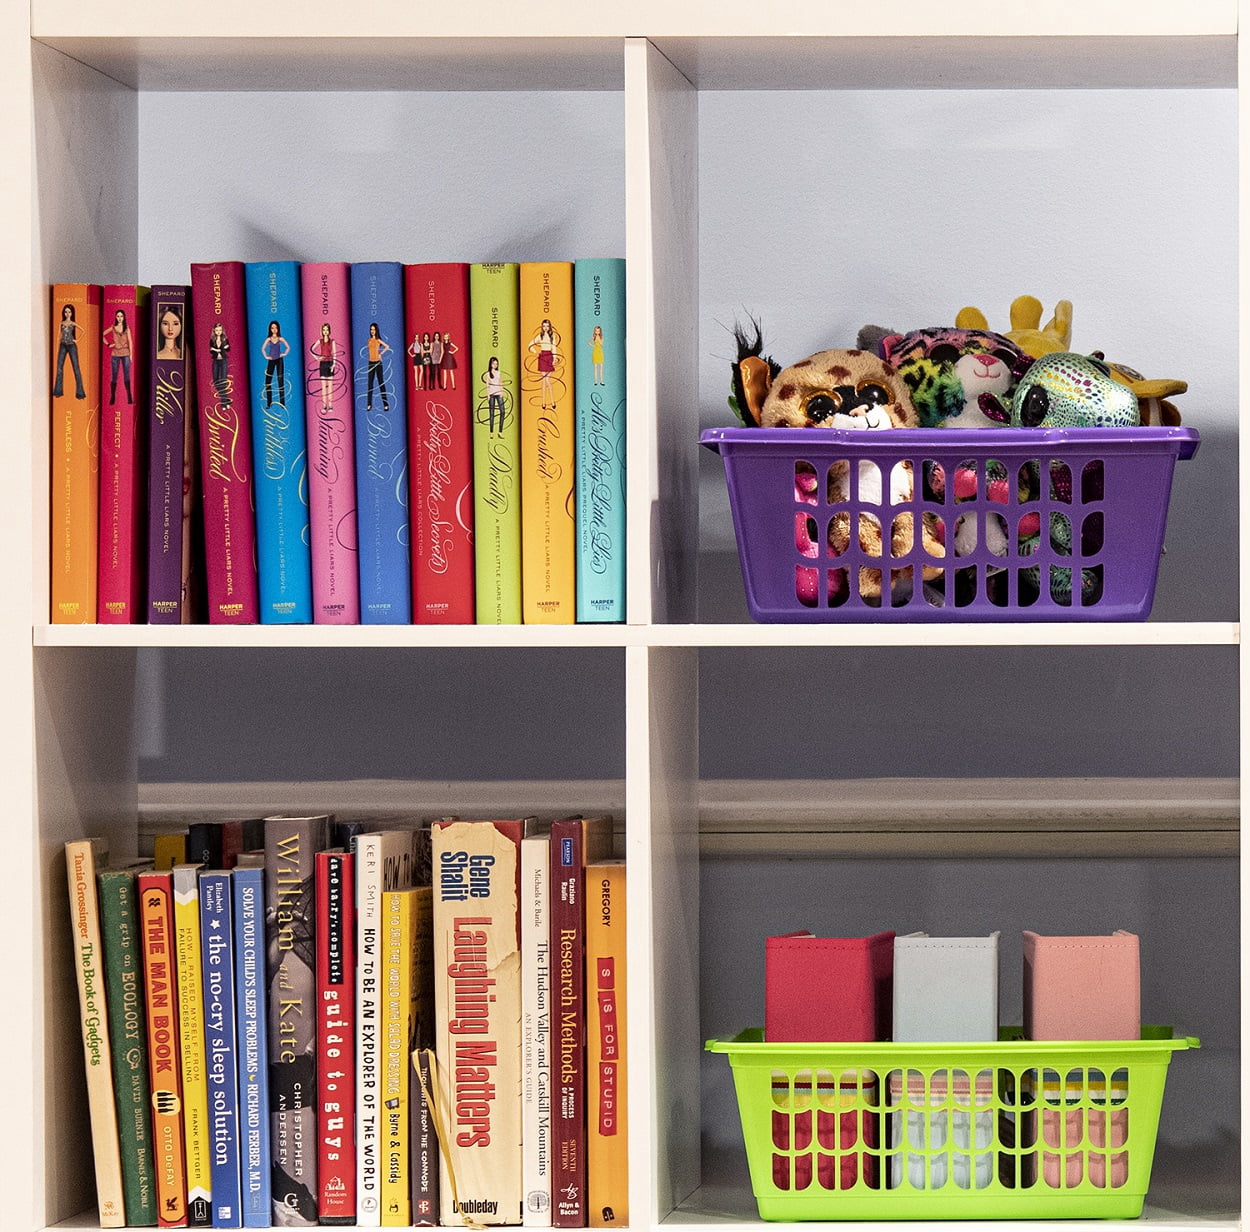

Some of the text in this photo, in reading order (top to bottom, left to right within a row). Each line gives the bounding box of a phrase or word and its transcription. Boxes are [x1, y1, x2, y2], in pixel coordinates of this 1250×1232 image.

[213, 274, 221, 315] SHEPARD
[491, 307, 499, 348] SHEPARD
[155, 368, 183, 424] Killer
[484, 443, 513, 514] Deadly
[537, 417, 561, 483] Crushed
[441, 851, 469, 902] Shalit
[469, 855, 495, 898] Gene
[601, 879, 611, 926] GREGORY
[277, 833, 303, 1064] William and Kate
[148, 916, 172, 1073] THE MAN BOOK
[560, 928, 577, 1083] Research Methods
[210, 935, 230, 1165] the no-cry sleep solution
[447, 917, 497, 1148] Laughing Matters
[293, 1083, 302, 1176] CHRISTOPHER
